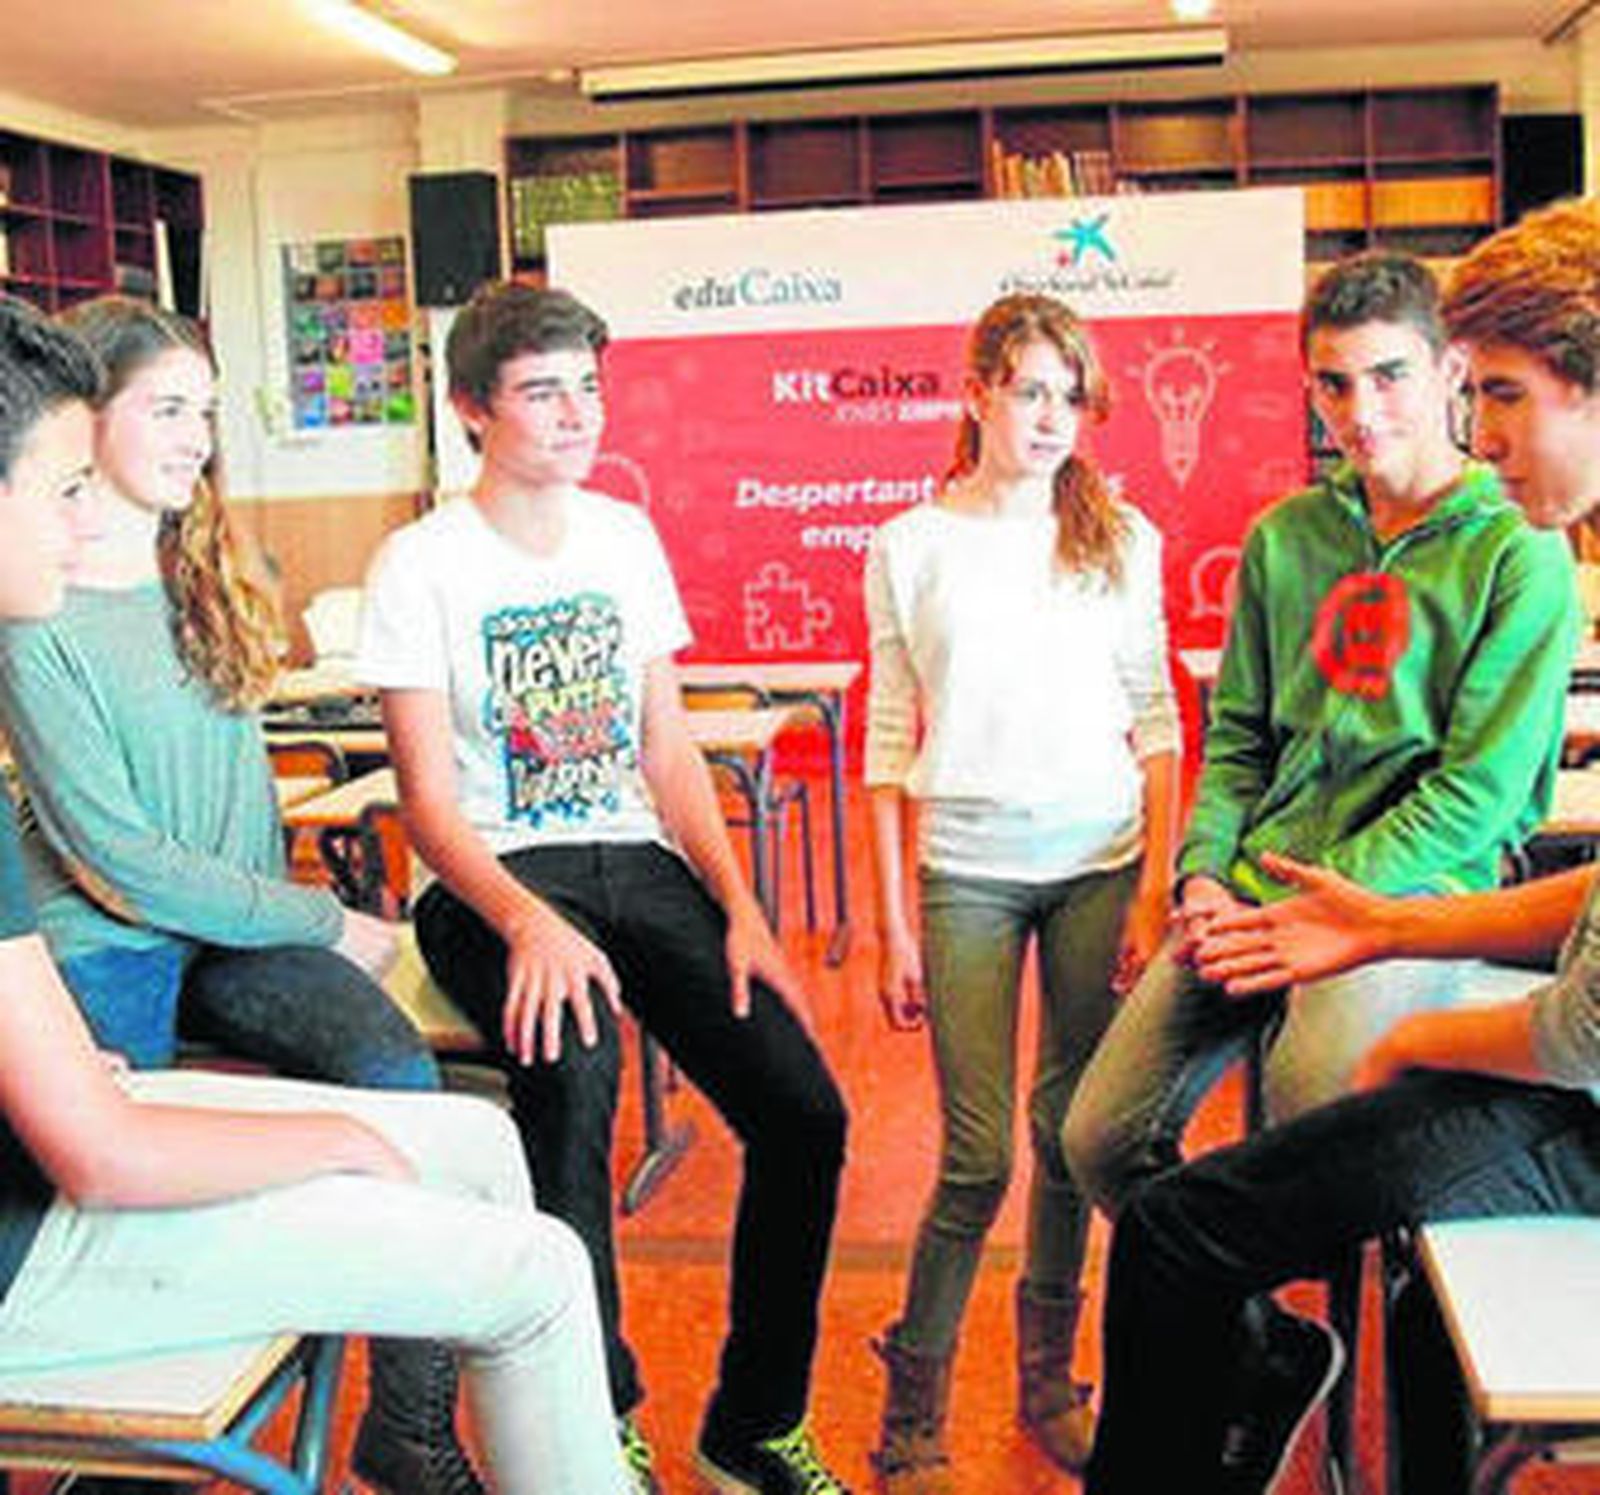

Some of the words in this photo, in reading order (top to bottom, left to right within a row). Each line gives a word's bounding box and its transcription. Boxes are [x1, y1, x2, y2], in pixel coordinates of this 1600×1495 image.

[673, 268, 842, 310] eduCaixa
[772, 366, 940, 402] KitCaixa
[736, 477, 934, 513] Despertant
